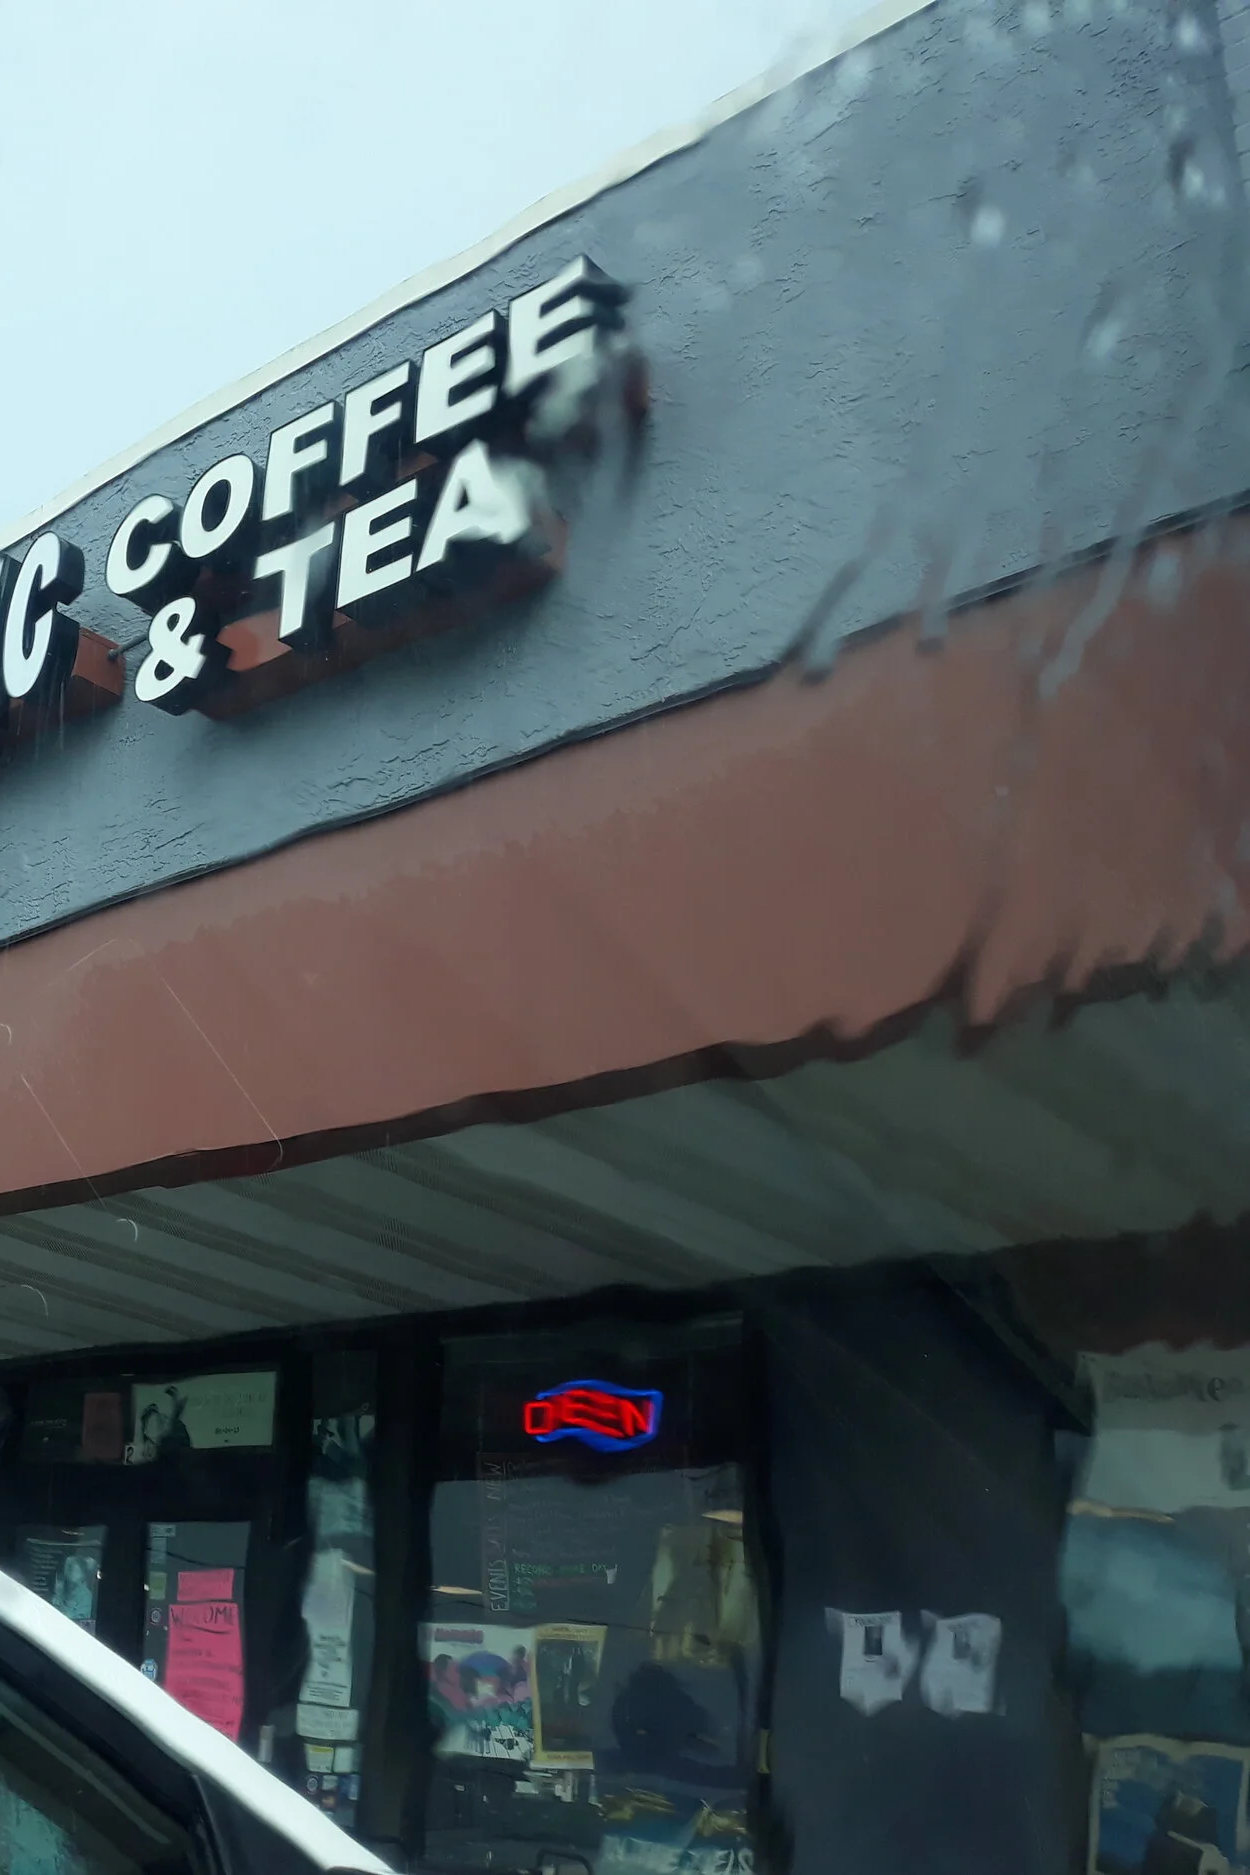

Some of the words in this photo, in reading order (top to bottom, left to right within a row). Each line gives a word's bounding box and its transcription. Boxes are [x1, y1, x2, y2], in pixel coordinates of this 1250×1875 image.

[106, 254, 600, 595] COFFEE
[135, 597, 206, 701] &
[254, 440, 533, 640] TEA
[524, 1389, 655, 1438] OEN
